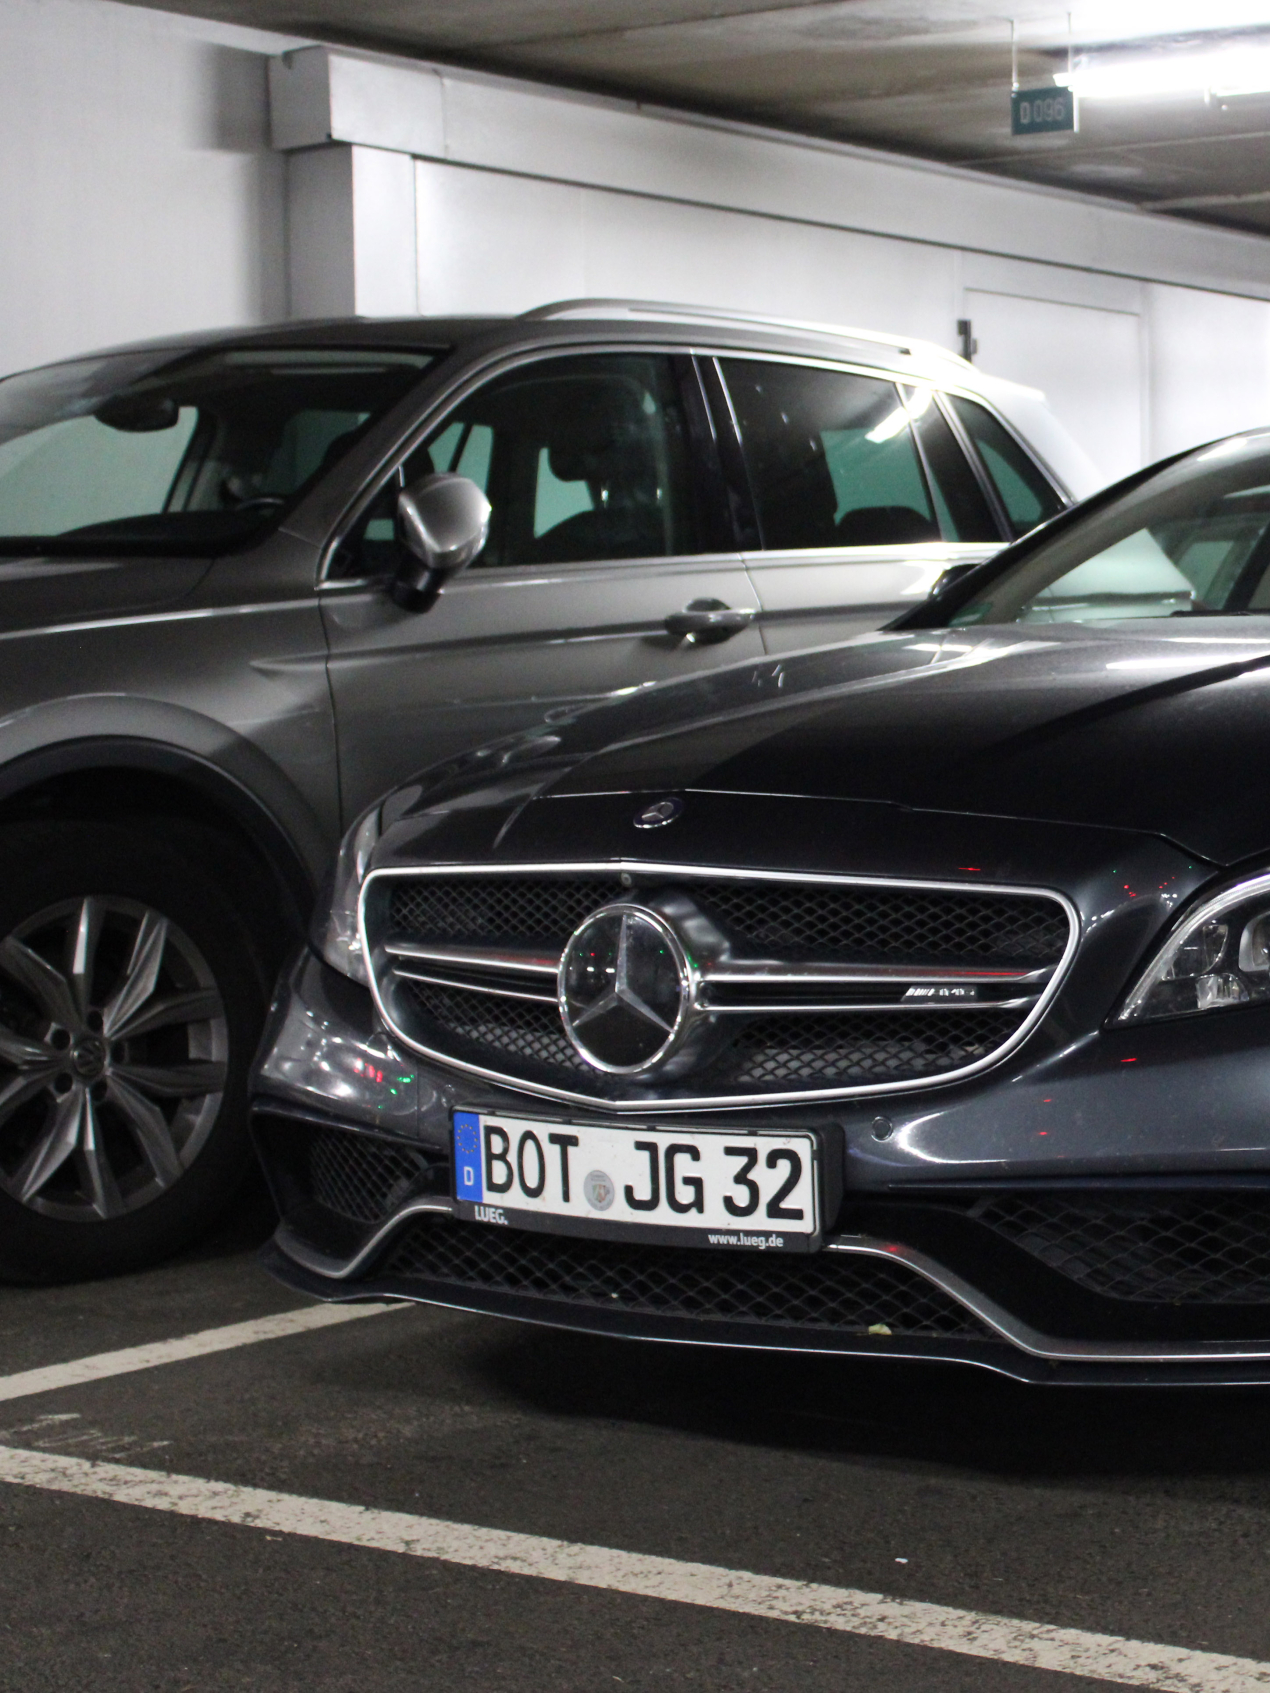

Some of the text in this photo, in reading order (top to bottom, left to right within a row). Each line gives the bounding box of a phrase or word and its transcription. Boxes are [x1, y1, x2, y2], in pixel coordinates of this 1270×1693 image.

[1033, 97, 1065, 122] 096
[463, 1166, 474, 1186] D
[483, 1124, 804, 1221] BOT JG 32
[708, 1232, 784, 1249] www.lueg.de
